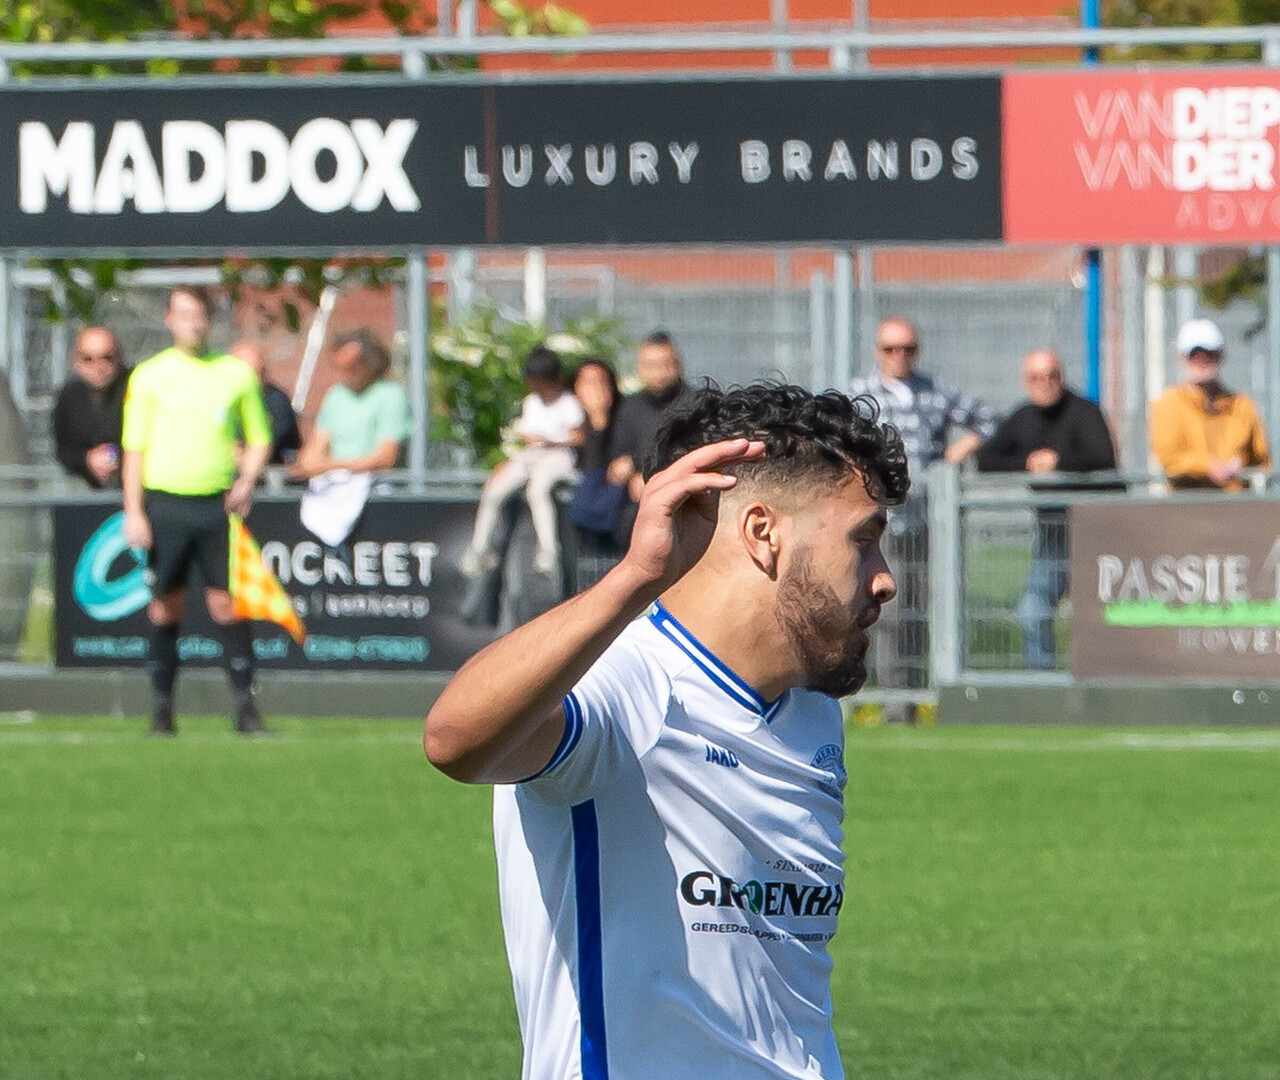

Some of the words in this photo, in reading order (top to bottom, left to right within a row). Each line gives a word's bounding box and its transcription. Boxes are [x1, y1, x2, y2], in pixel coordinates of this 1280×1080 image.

[1073, 90, 1172, 140] VAN
[17, 117, 420, 214] MADDOX
[464, 140, 700, 188] LUXURY
[740, 136, 980, 184] BRANDS
[1073, 142, 1172, 191] VAN
[1172, 139, 1276, 191] DER
[1098, 553, 1250, 604] PASSIE
